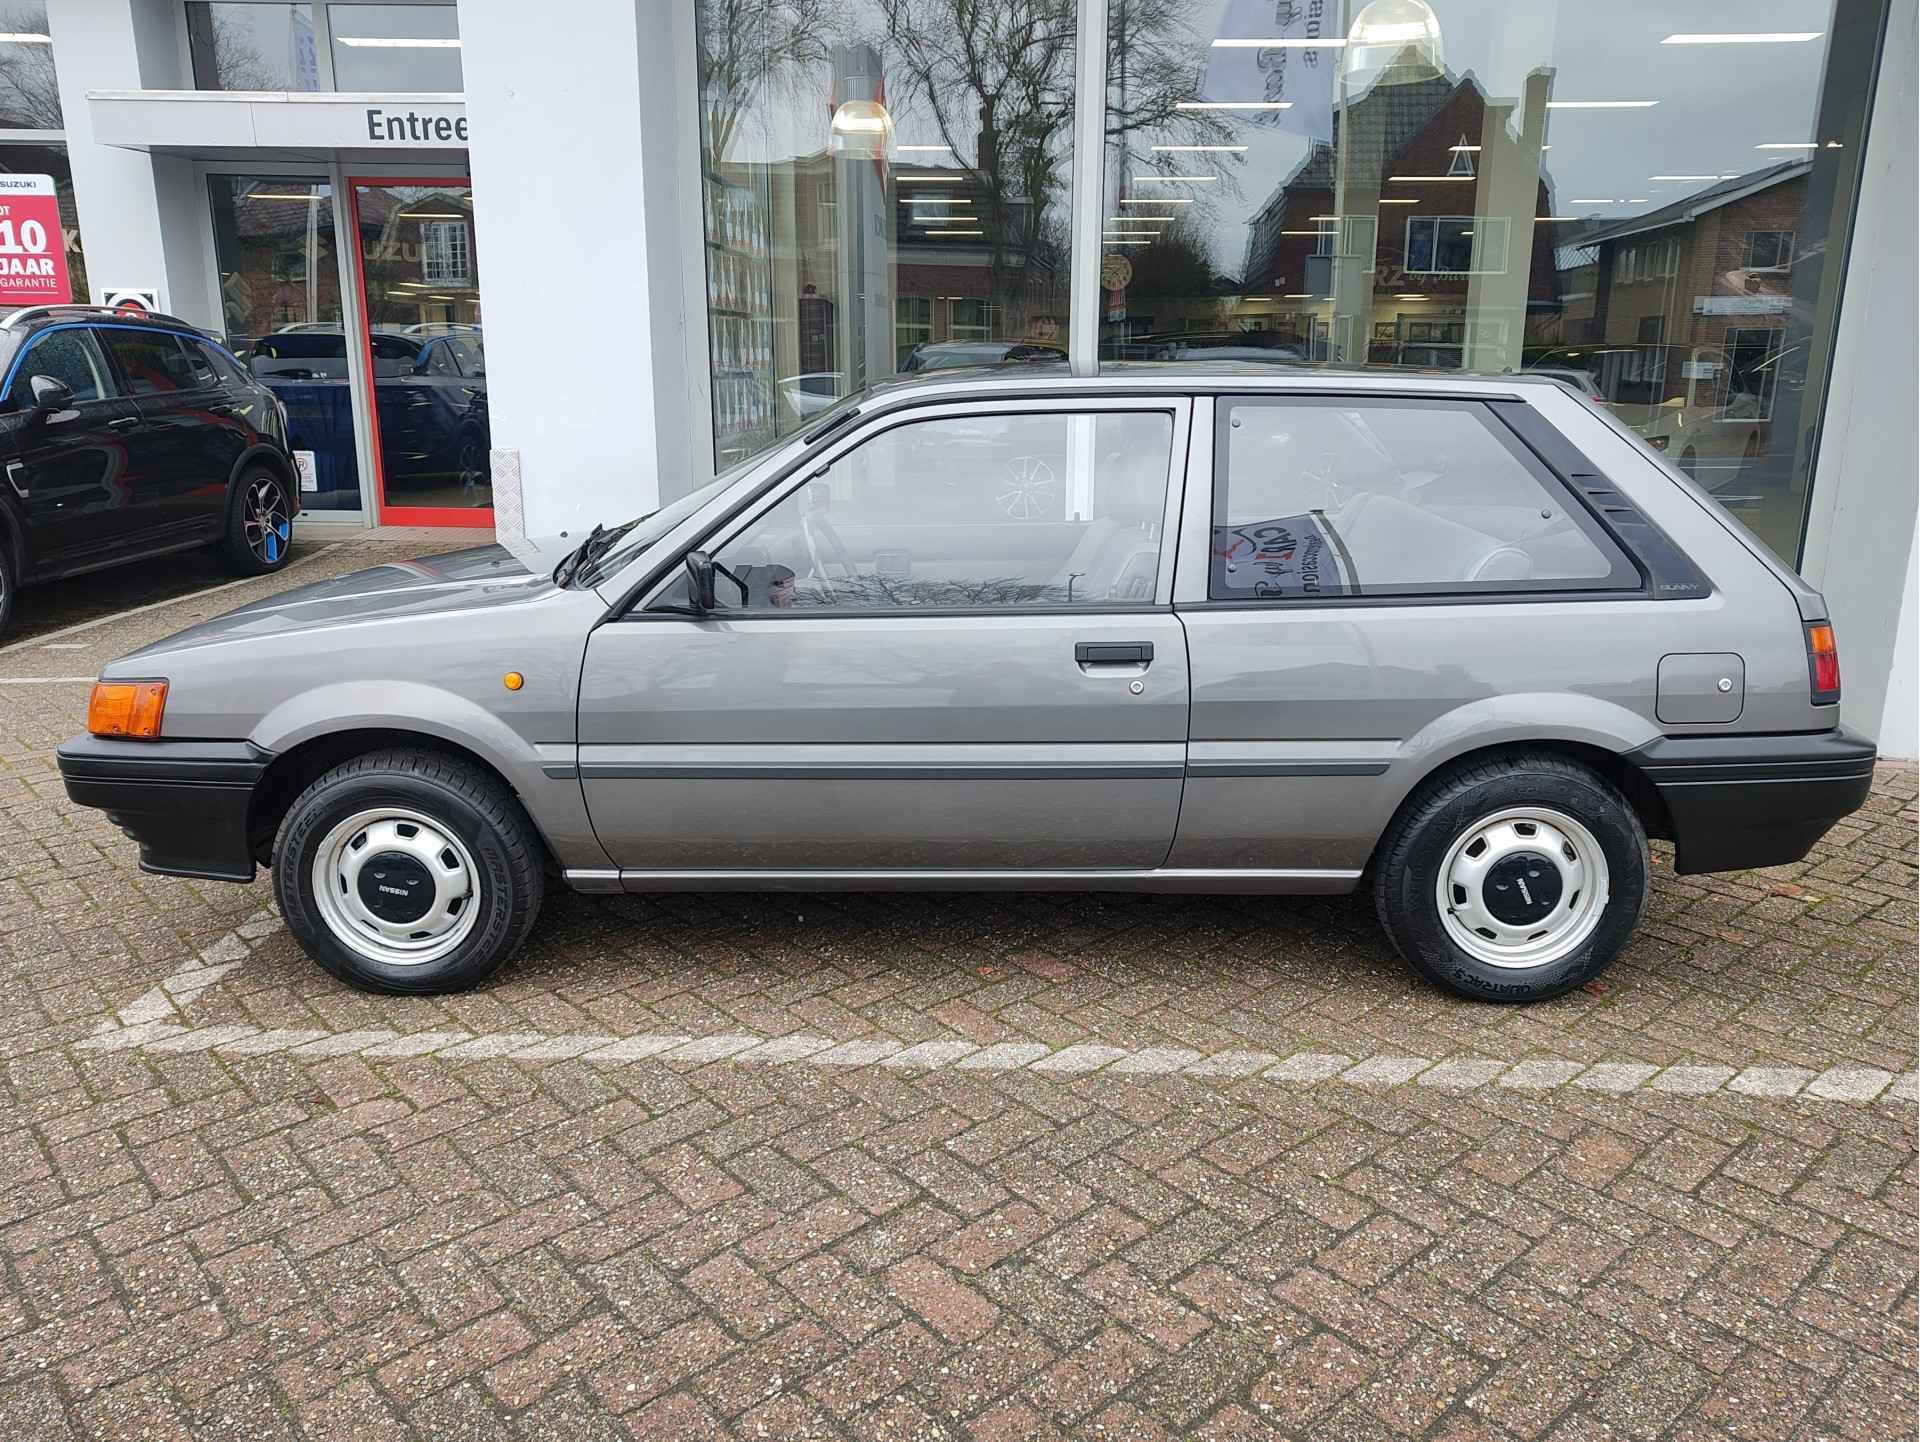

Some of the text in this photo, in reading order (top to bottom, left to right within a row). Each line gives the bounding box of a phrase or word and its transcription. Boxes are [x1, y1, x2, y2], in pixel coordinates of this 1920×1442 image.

[366, 109, 469, 141] Entree
[0, 219, 48, 254] 10
[0, 257, 56, 276] JAAR
[0, 277, 58, 289] GARANTIE
[378, 884, 409, 898] NISSAN
